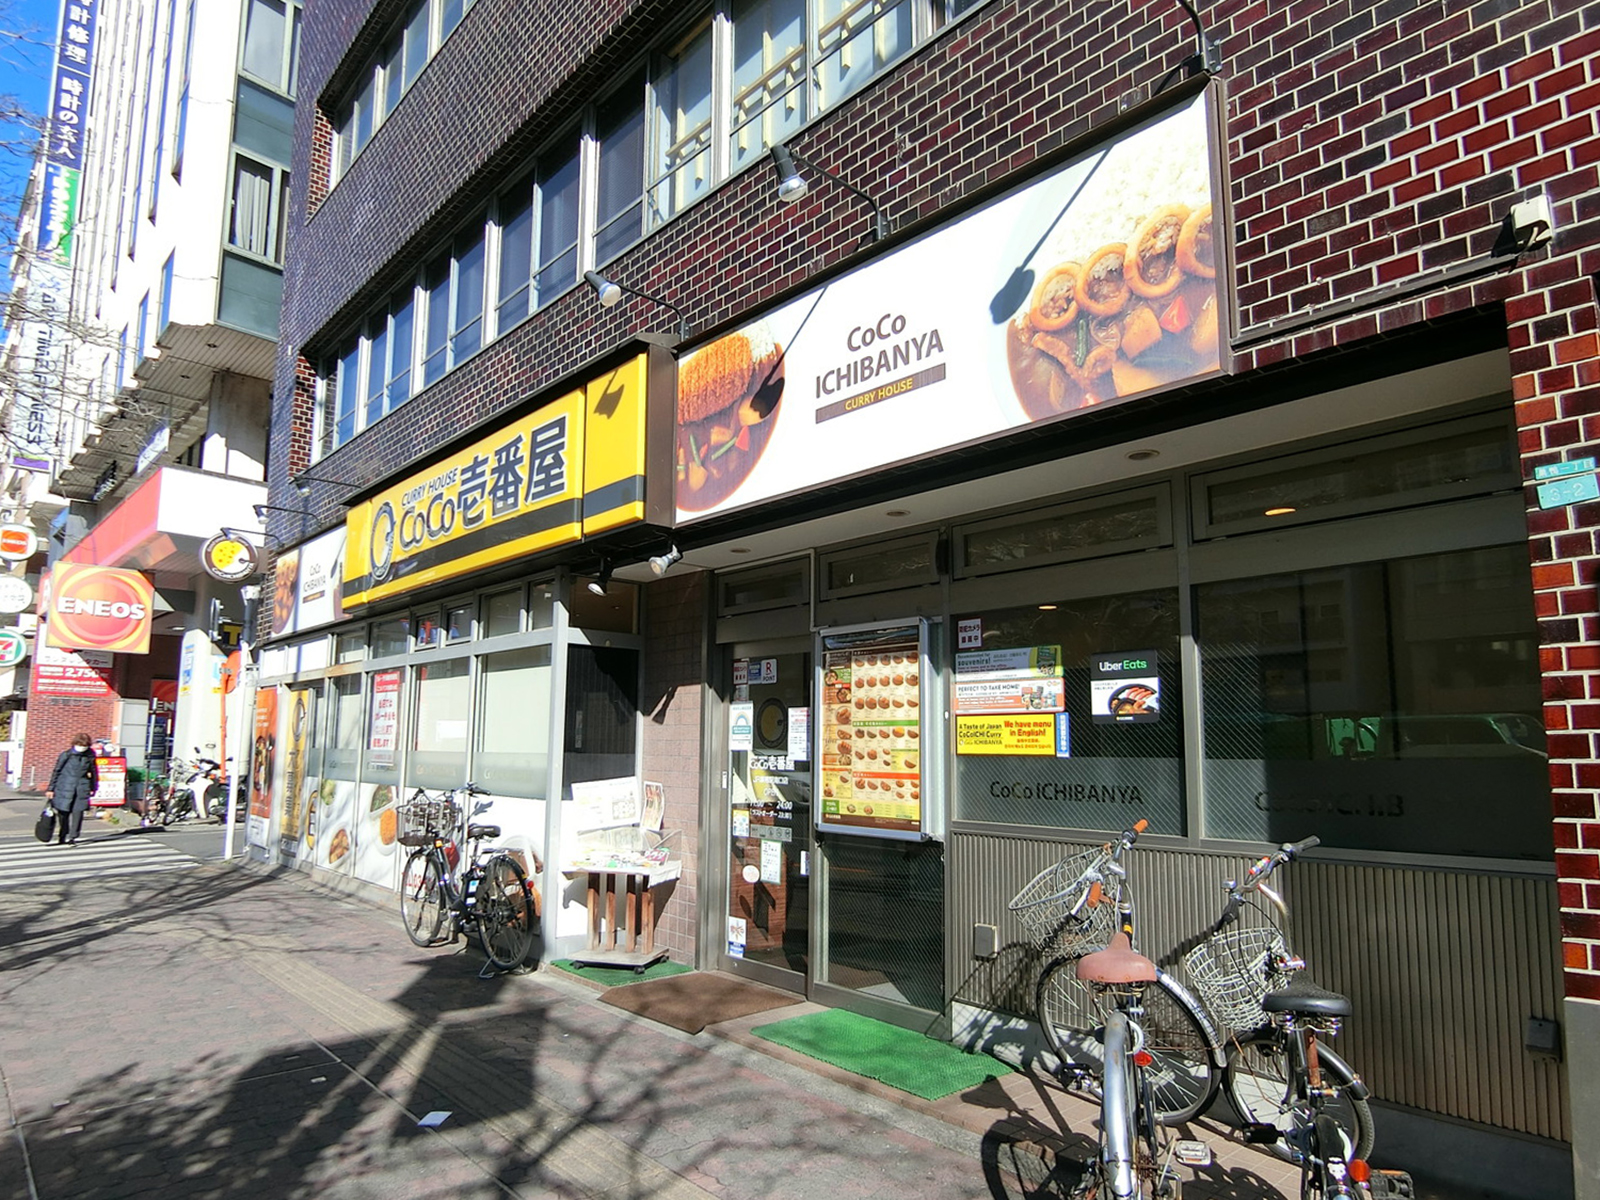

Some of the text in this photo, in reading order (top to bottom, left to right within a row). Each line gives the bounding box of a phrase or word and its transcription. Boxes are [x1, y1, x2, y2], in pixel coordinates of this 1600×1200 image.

[64, 0, 94, 65] 計修理
[847, 313, 906, 352] CoCo
[816, 329, 944, 399] ICHIBANYA
[845, 378, 913, 410] CURRY HOUSE
[400, 415, 567, 549] CoCo壱番屋
[402, 467, 458, 507] CURRY HOUSE
[57, 596, 146, 621] ENEOS
[1099, 660, 1147, 671] Uber Eats
[1004, 720, 1013, 728] We
[1014, 720, 1031, 728] have
[1017, 728, 1046, 737] English!
[990, 781, 1144, 804] CoCo ICHIBANYA
